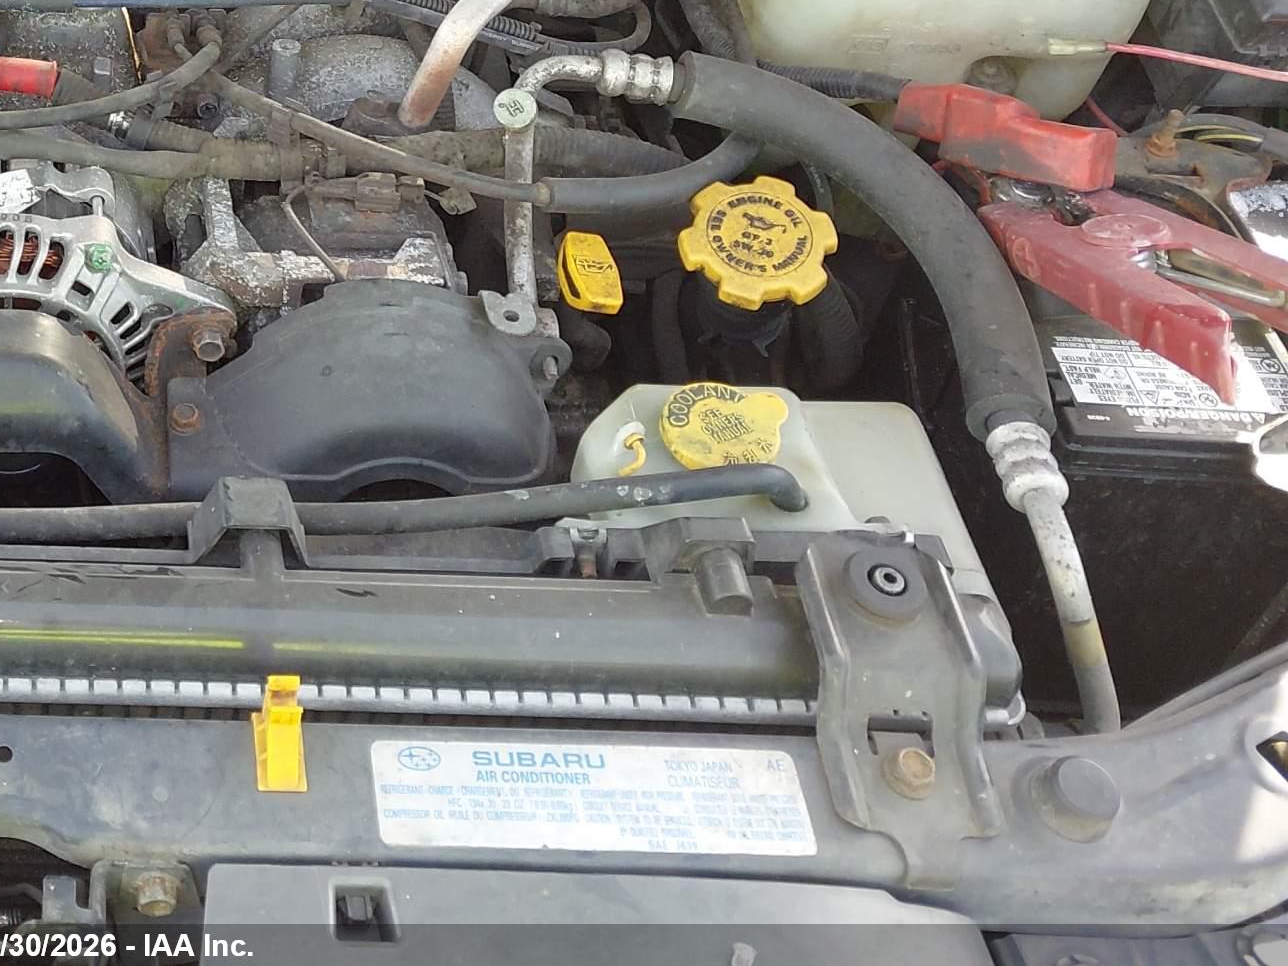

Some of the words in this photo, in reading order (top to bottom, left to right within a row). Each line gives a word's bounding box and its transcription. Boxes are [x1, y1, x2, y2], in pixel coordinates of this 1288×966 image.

[727, 195, 783, 210] ENGINE
[784, 209, 804, 229] OIL
[710, 209, 727, 232] SEE
[772, 234, 808, 272] MANUAL
[669, 384, 745, 427] COOLANT
[472, 750, 605, 769] SUBARU
[664, 759, 697, 772] TOKYO
[701, 760, 733, 773] JAPAN
[476, 770, 497, 783] AIR
[501, 770, 591, 785] CONDITIONER
[667, 775, 740, 789] CLIMATISEUR
